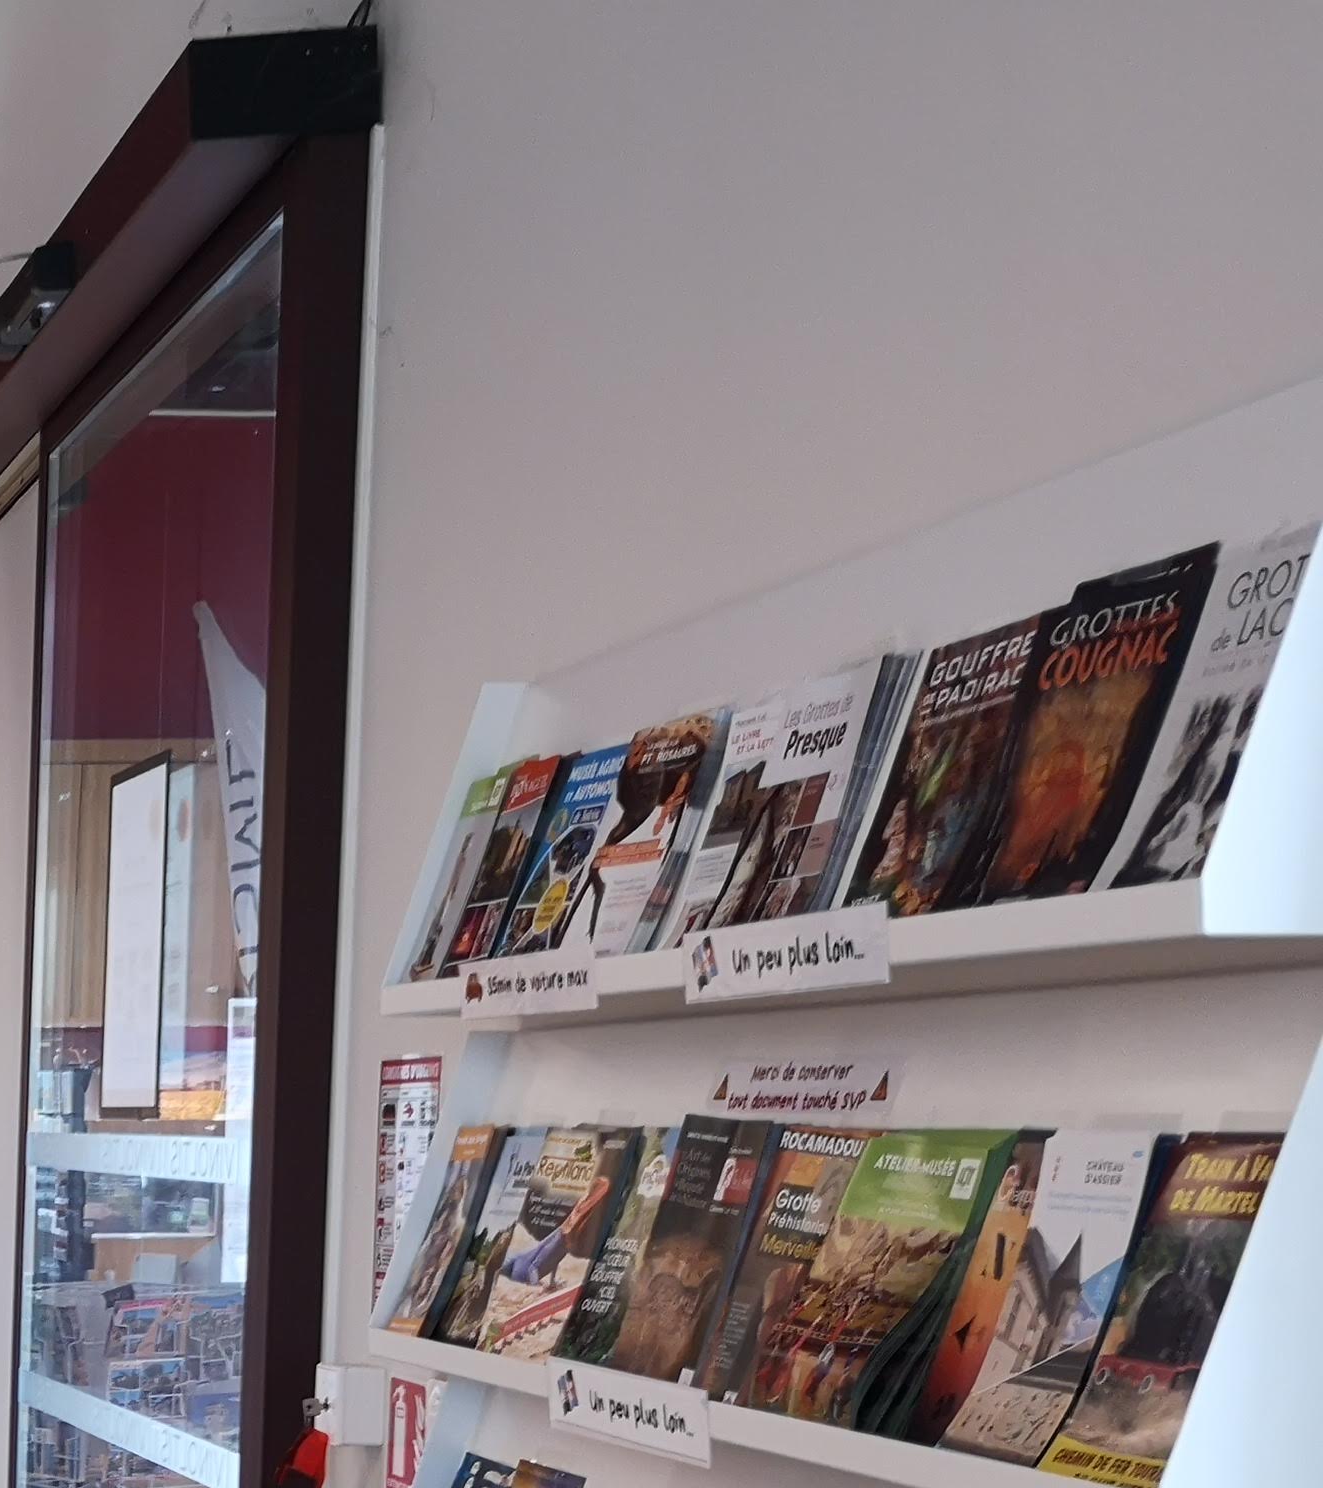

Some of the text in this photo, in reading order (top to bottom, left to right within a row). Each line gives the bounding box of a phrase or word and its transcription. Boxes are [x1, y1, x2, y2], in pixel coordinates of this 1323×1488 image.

[1050, 591, 1180, 648] GROTTES
[930, 629, 1038, 687] GOUFFRE
[1038, 620, 1181, 691] COUGNAC
[935, 662, 1027, 711] PADIRAC
[783, 721, 849, 760] Presque
[731, 947, 752, 975] Un
[757, 945, 785, 979] peu
[786, 935, 820, 974] plus
[565, 967, 588, 989] max
[782, 1061, 795, 1081] de
[797, 1063, 855, 1081] conserver
[727, 1089, 868, 1111] tout document touché SVP
[774, 1188, 823, 1213] Grotte
[588, 1390, 606, 1413] Un
[609, 1396, 632, 1424] peu
[633, 1401, 659, 1430] plus
